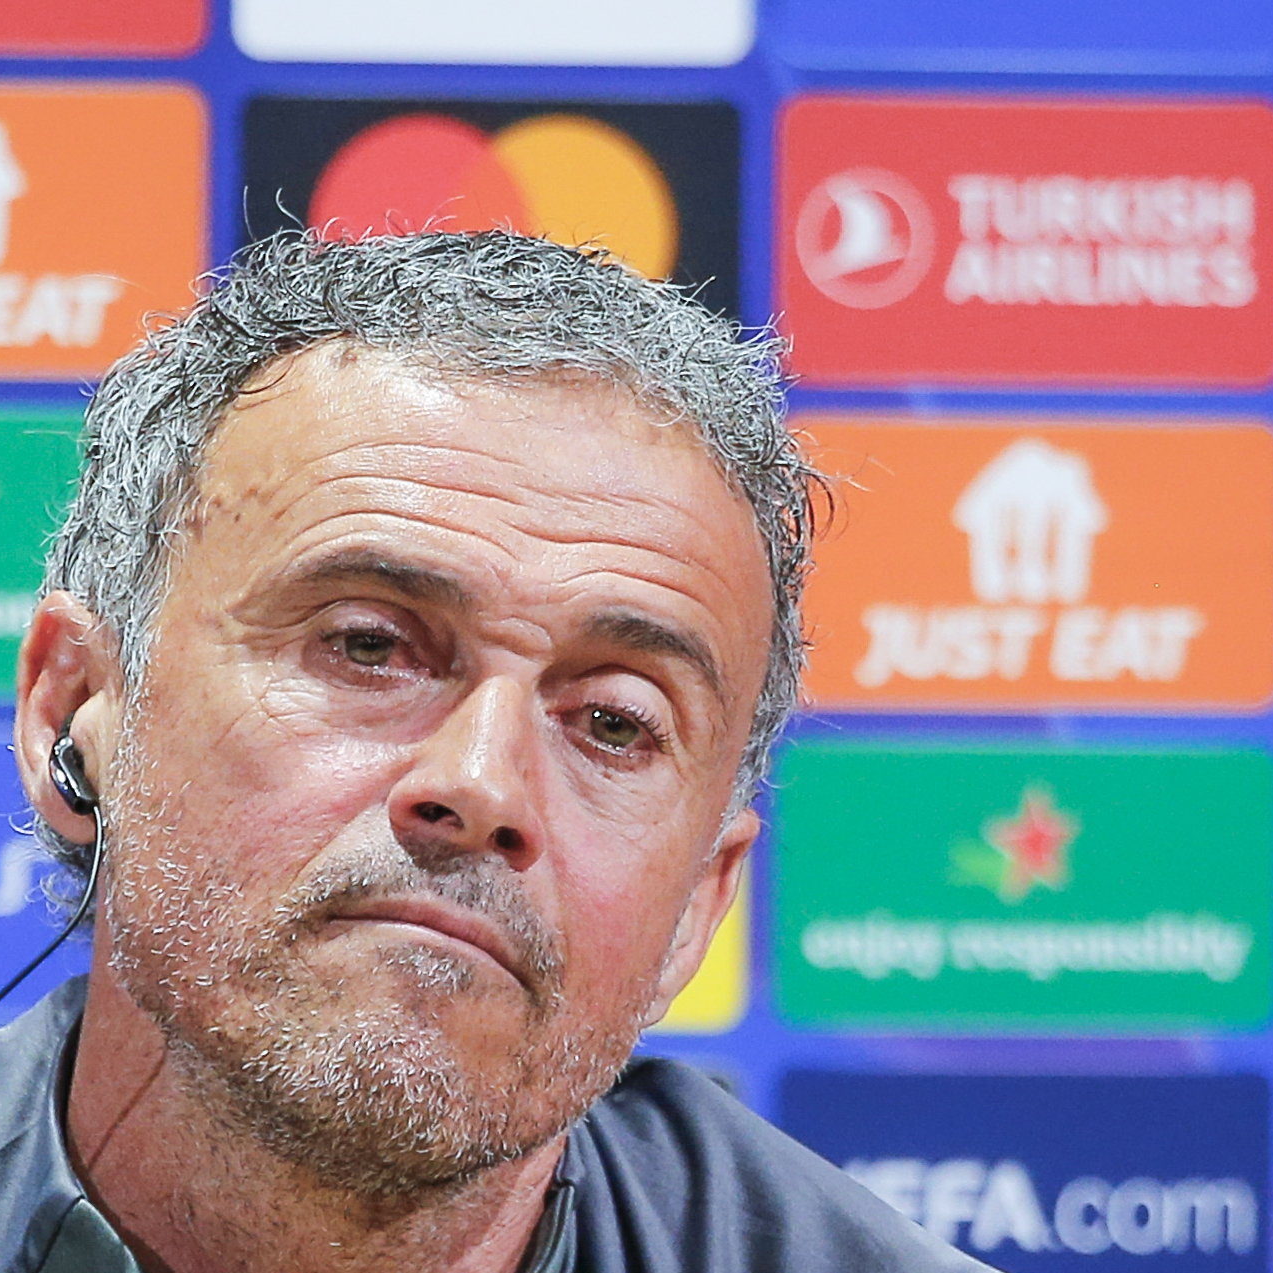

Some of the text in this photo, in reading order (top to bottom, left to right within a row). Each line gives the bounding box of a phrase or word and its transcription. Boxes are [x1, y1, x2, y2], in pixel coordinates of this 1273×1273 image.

[947, 175, 1254, 241] TURKISH
[945, 243, 1257, 307] AIRLINES
[855, 605, 1204, 687] JUST EAT
[949, 914, 1251, 982] responsibly
[842, 1157, 1258, 1255] EFA.com
